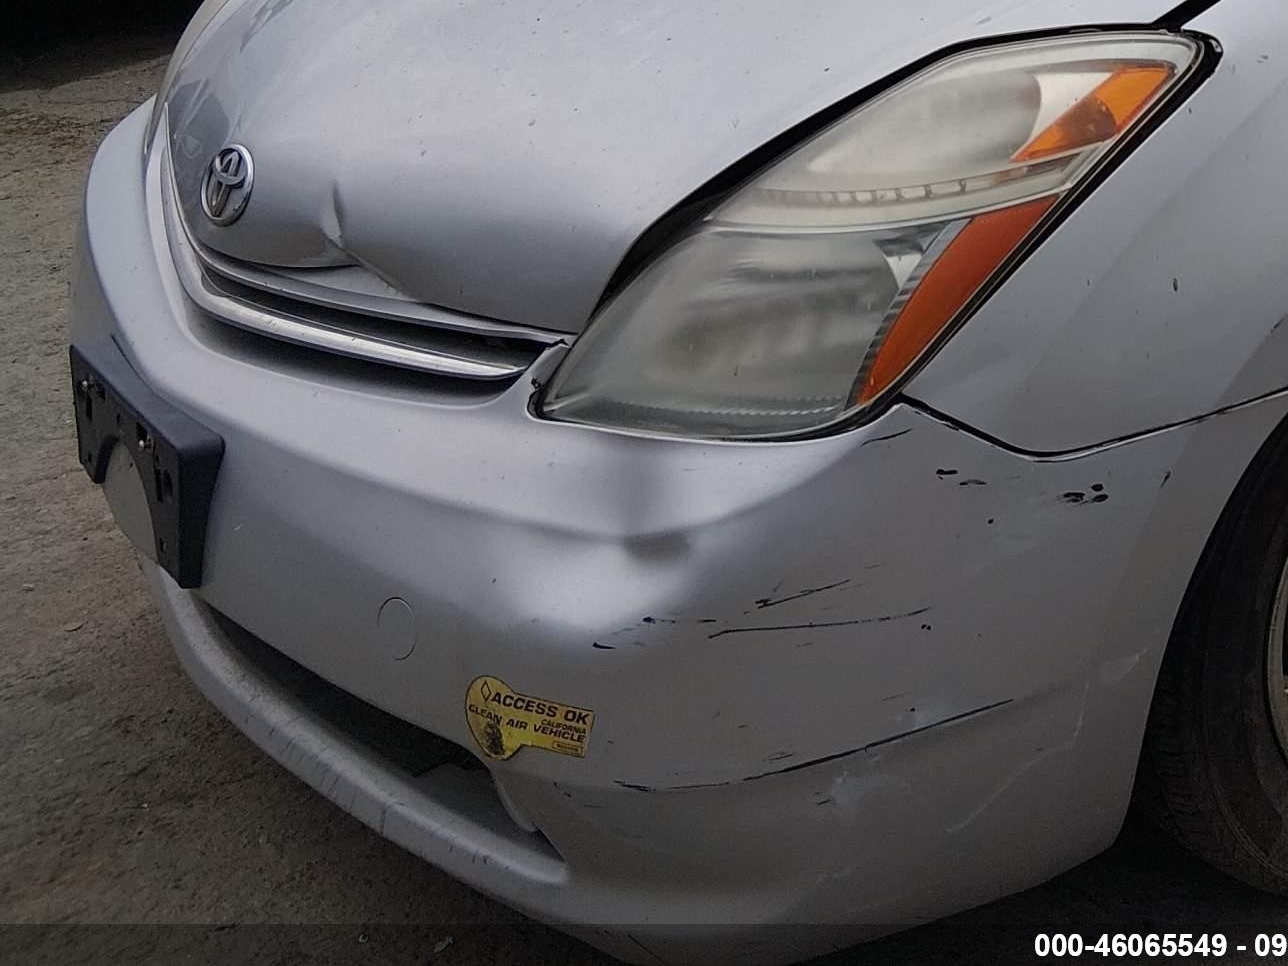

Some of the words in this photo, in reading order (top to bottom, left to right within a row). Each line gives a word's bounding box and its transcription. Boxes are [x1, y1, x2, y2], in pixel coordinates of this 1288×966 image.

[468, 704, 503, 725] CLEAN
[506, 718, 529, 731] AIR
[533, 724, 586, 743] VEHICLE
[490, 692, 558, 718] ACCESS
[564, 709, 590, 725] OK
[541, 718, 587, 734] CALIFORNIA
